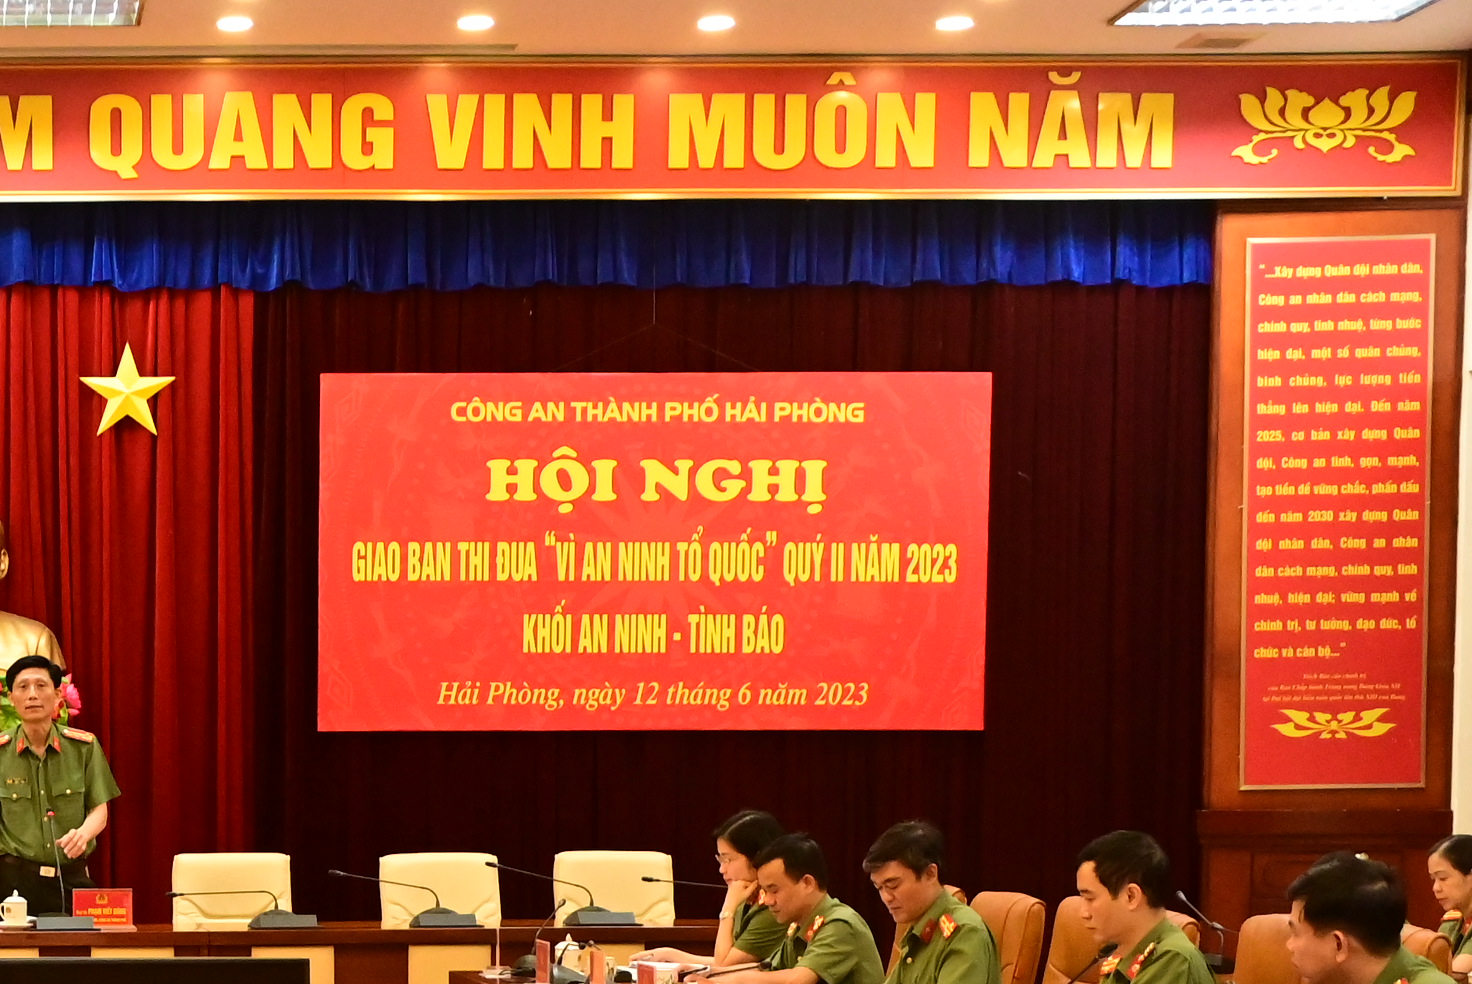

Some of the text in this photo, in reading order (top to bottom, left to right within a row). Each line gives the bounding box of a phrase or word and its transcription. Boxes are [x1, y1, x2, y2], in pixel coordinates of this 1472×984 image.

[89, 92, 394, 179] QUANG
[426, 93, 634, 169] VINH
[668, 72, 936, 169] MUÔN
[968, 72, 1175, 169] NĂM
[450, 393, 865, 423] CÔNG AN THÀNH PHỐ HẢI PHÒNG
[1256, 430, 1285, 442] 2025,
[485, 445, 828, 515] HỘI NGHỊ
[1307, 510, 1334, 522] 2030
[352, 525, 958, 587] GIAO BAN THI ĐUA “VÌ AN NINH TỔ QUỐC” QUÝ II NĂM 2023
[522, 599, 572, 654] KHỐI
[577, 613, 608, 654] AN
[614, 613, 667, 654] NINH
[687, 605, 736, 654] TÌNH
[742, 605, 785, 654] BÁO
[437, 680, 869, 711] Hải Phòng, ngày 12 tháng 6 năm 2023
